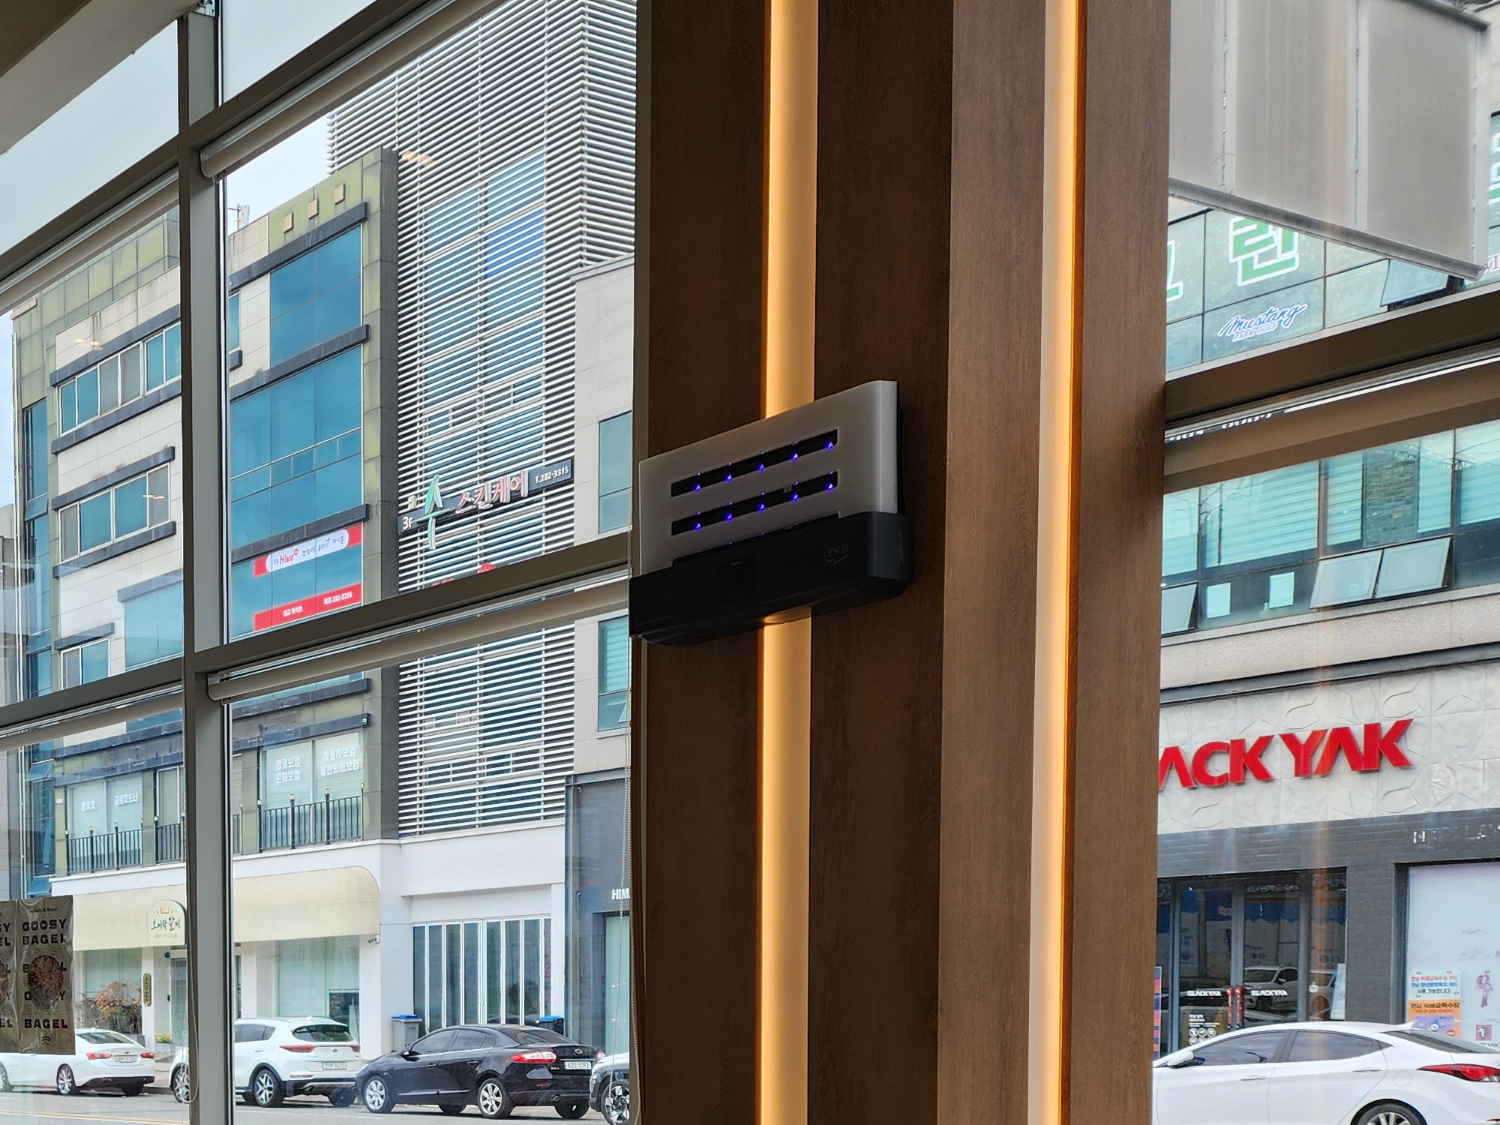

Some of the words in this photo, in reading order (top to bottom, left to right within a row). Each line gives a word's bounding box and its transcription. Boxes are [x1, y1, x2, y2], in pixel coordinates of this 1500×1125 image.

[1217, 304, 1308, 338] Mustang
[402, 516, 414, 530] 3F
[456, 469, 529, 514] 스킨케어
[22, 918, 67, 931] GOOSY
[22, 933, 67, 945] BAGEL
[24, 1019, 68, 1028] BAGEL
